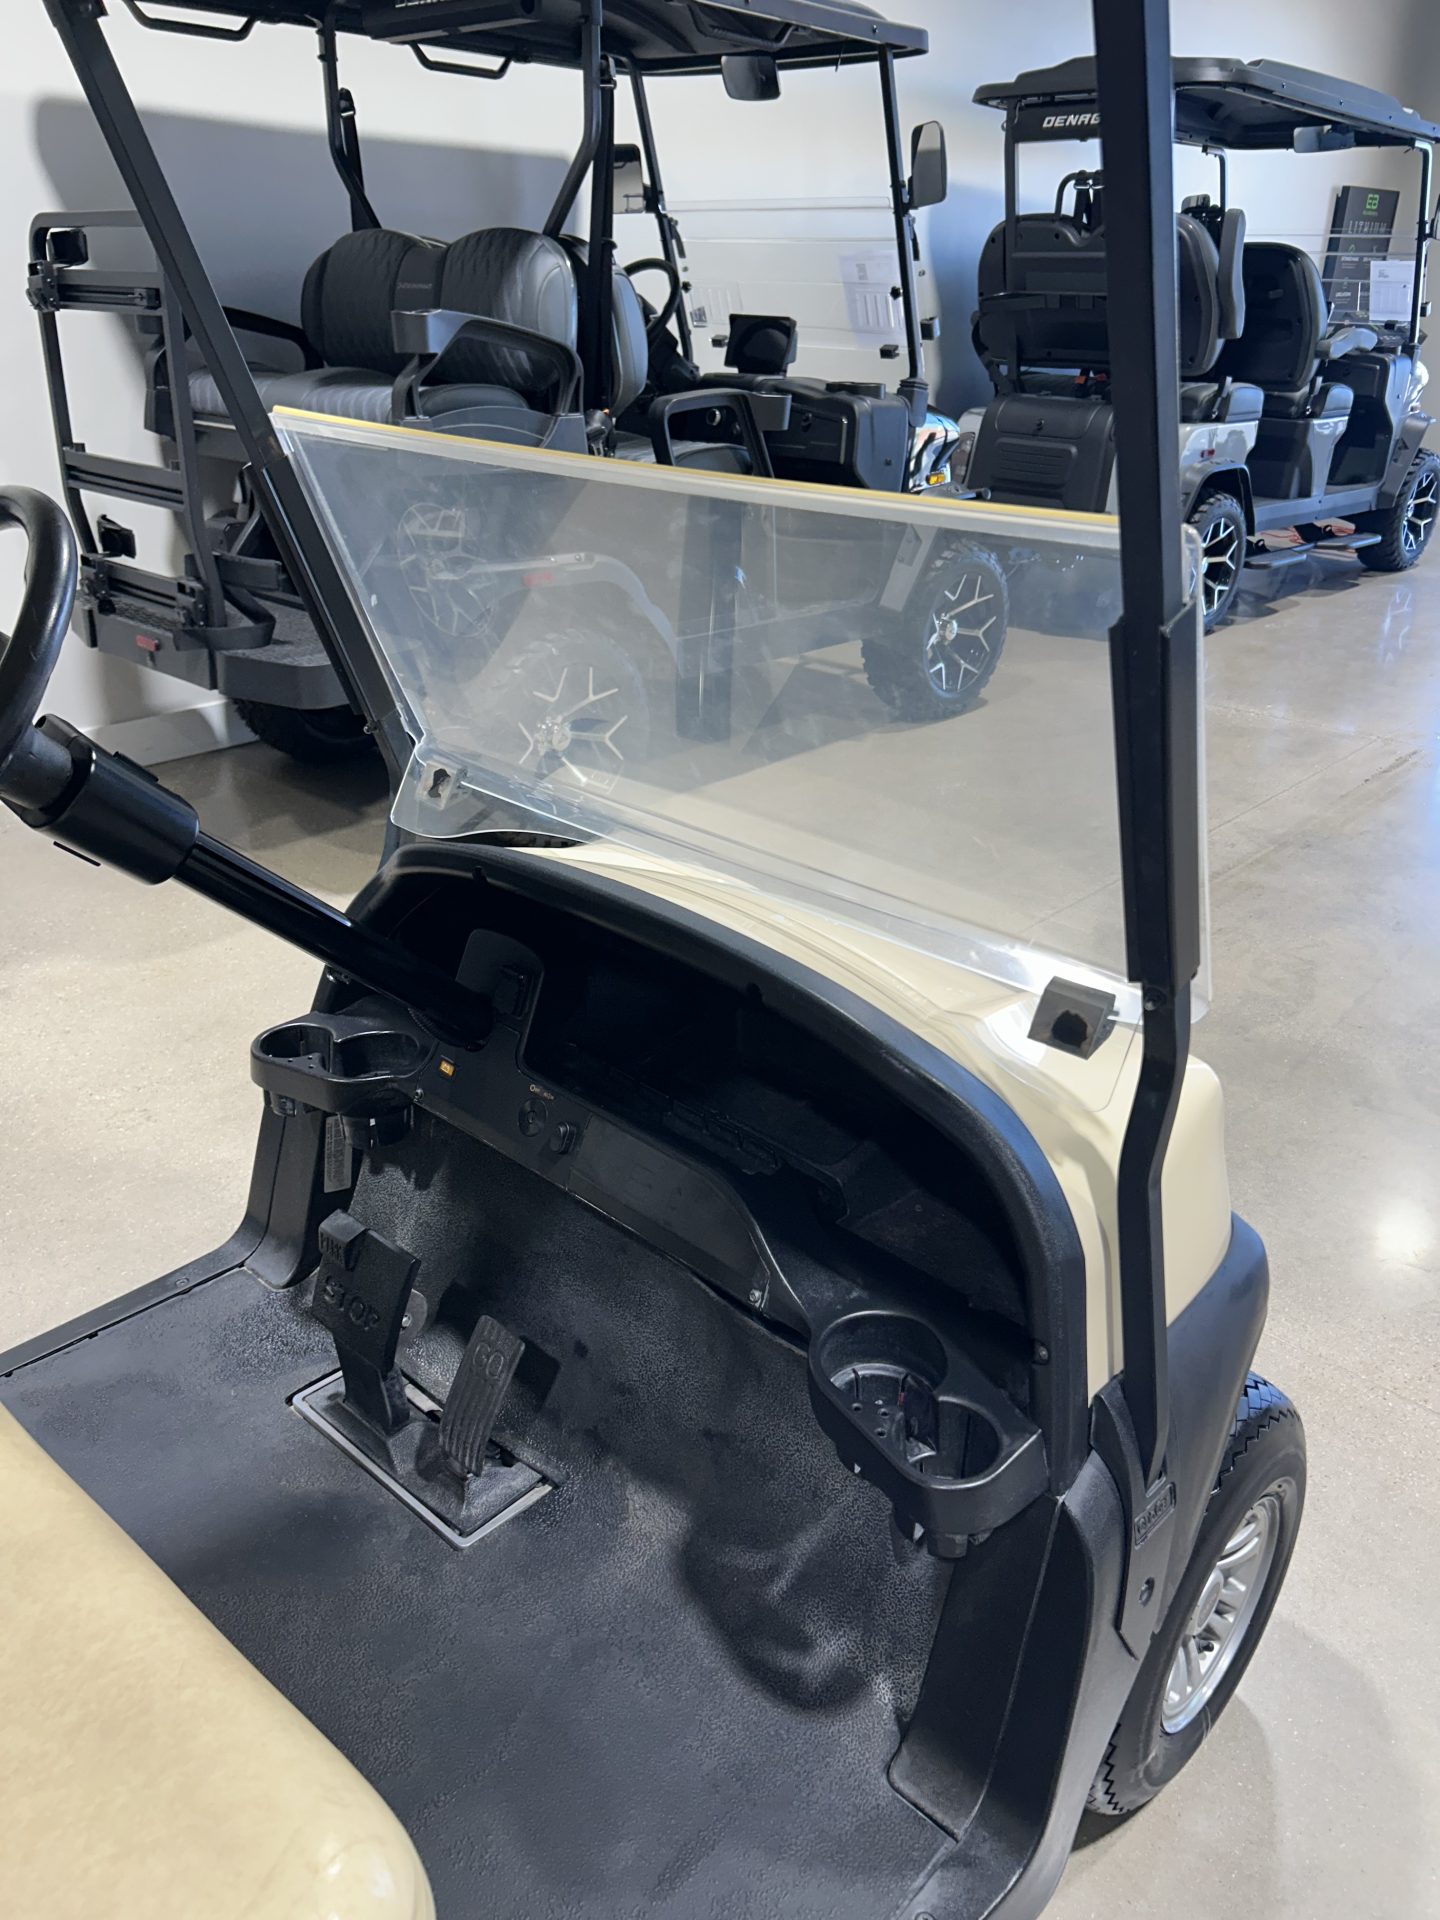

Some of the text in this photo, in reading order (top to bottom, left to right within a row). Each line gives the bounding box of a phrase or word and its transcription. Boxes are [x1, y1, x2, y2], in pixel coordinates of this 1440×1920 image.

[1042, 113, 1101, 128] DENAG
[1348, 220, 1387, 234] LITHIUM
[323, 1275, 380, 1331] STOP
[472, 1342, 504, 1379] GO
